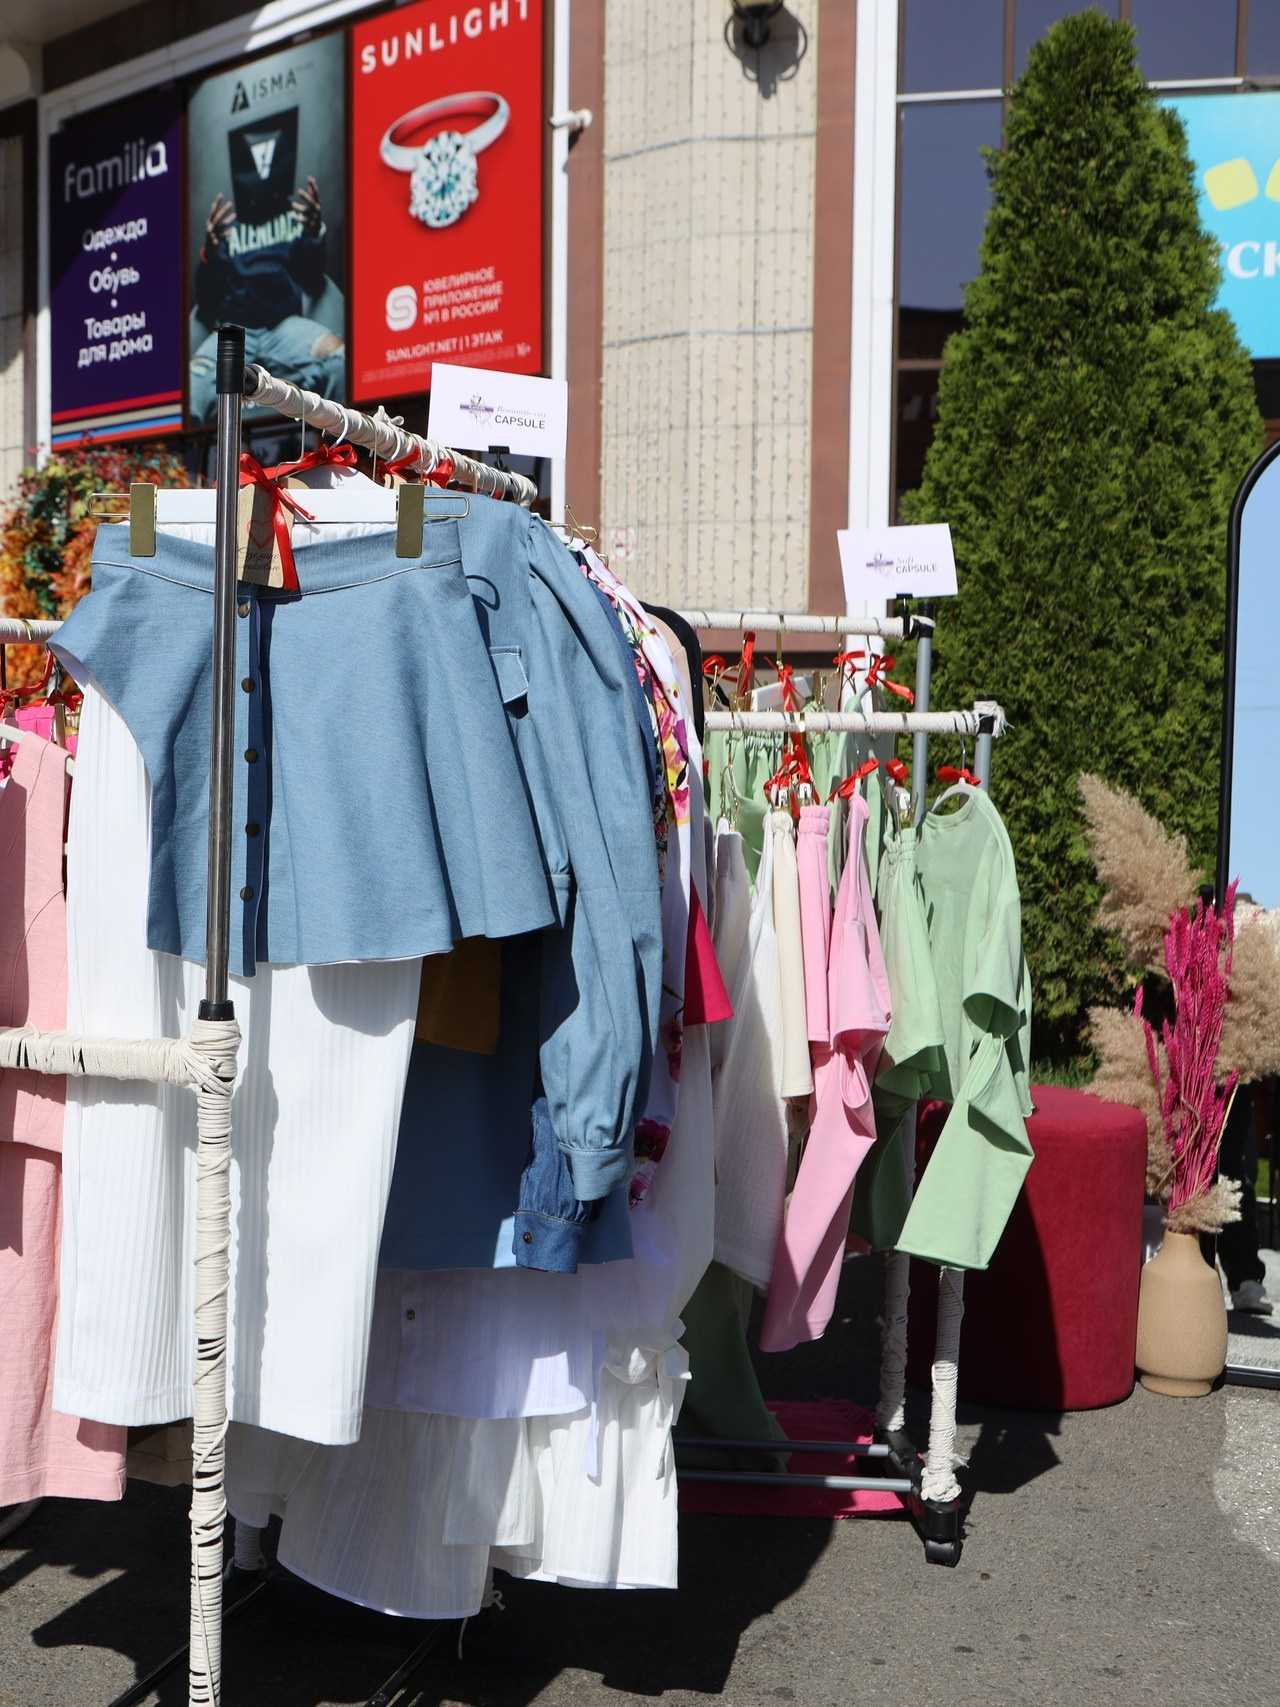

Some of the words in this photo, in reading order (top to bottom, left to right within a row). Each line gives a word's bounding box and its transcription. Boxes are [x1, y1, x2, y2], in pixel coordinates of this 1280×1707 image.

[361, 0, 528, 74] SUNLIGHT
[64, 138, 168, 202] familia
[82, 217, 148, 251] Одежда
[89, 265, 140, 294] Обувь
[423, 266, 495, 294] ЮВЕЛИРНОЕ
[423, 281, 503, 311] ПРИЛОЖЕНИЕ
[84, 311, 146, 340] Товары
[78, 341, 107, 369] для
[108, 333, 153, 361] дома
[386, 338, 457, 363] SUNLIGHT.NET
[471, 329, 503, 346] ЭТАЖ
[494, 413, 547, 430] CAPSULE
[895, 563, 938, 574] CAPSULE
